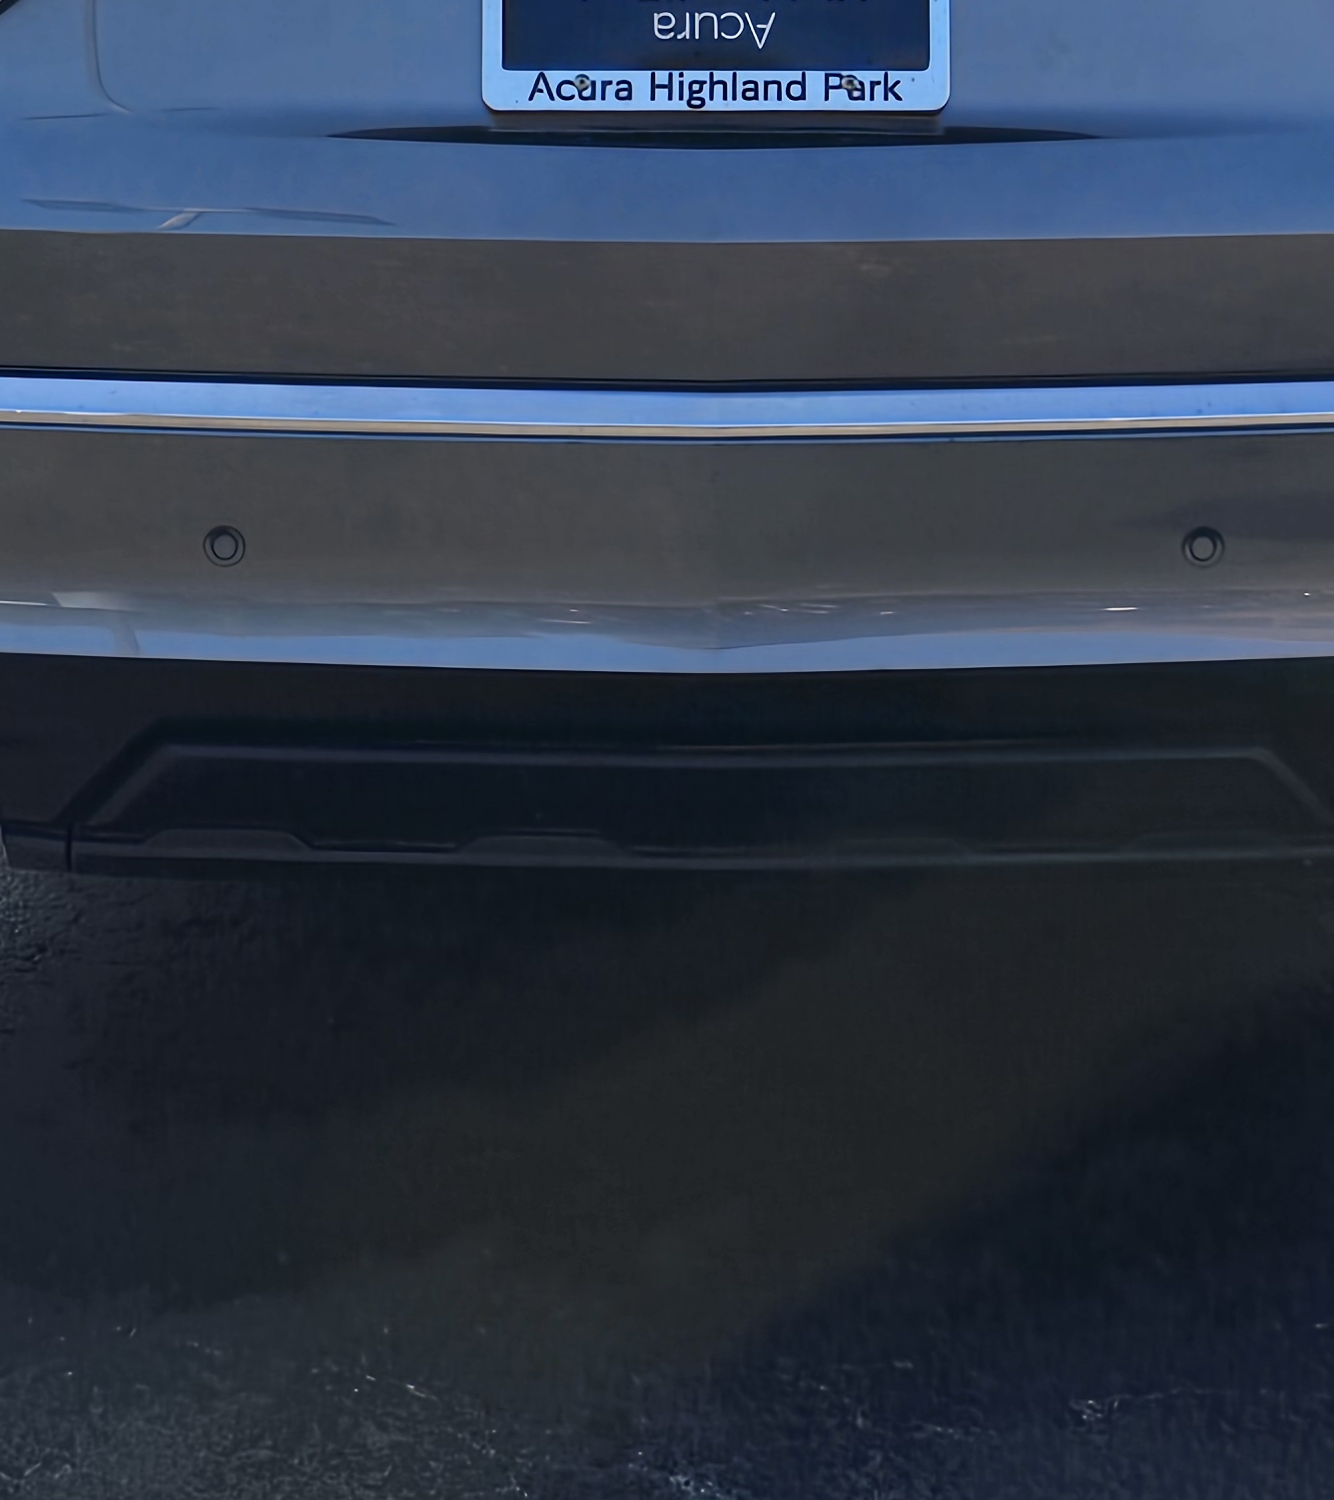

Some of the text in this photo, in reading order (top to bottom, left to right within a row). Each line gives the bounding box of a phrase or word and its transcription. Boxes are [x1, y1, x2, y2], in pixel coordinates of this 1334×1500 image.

[653, 11, 775, 49] Acura
[528, 71, 903, 109] Acura Highland Park
